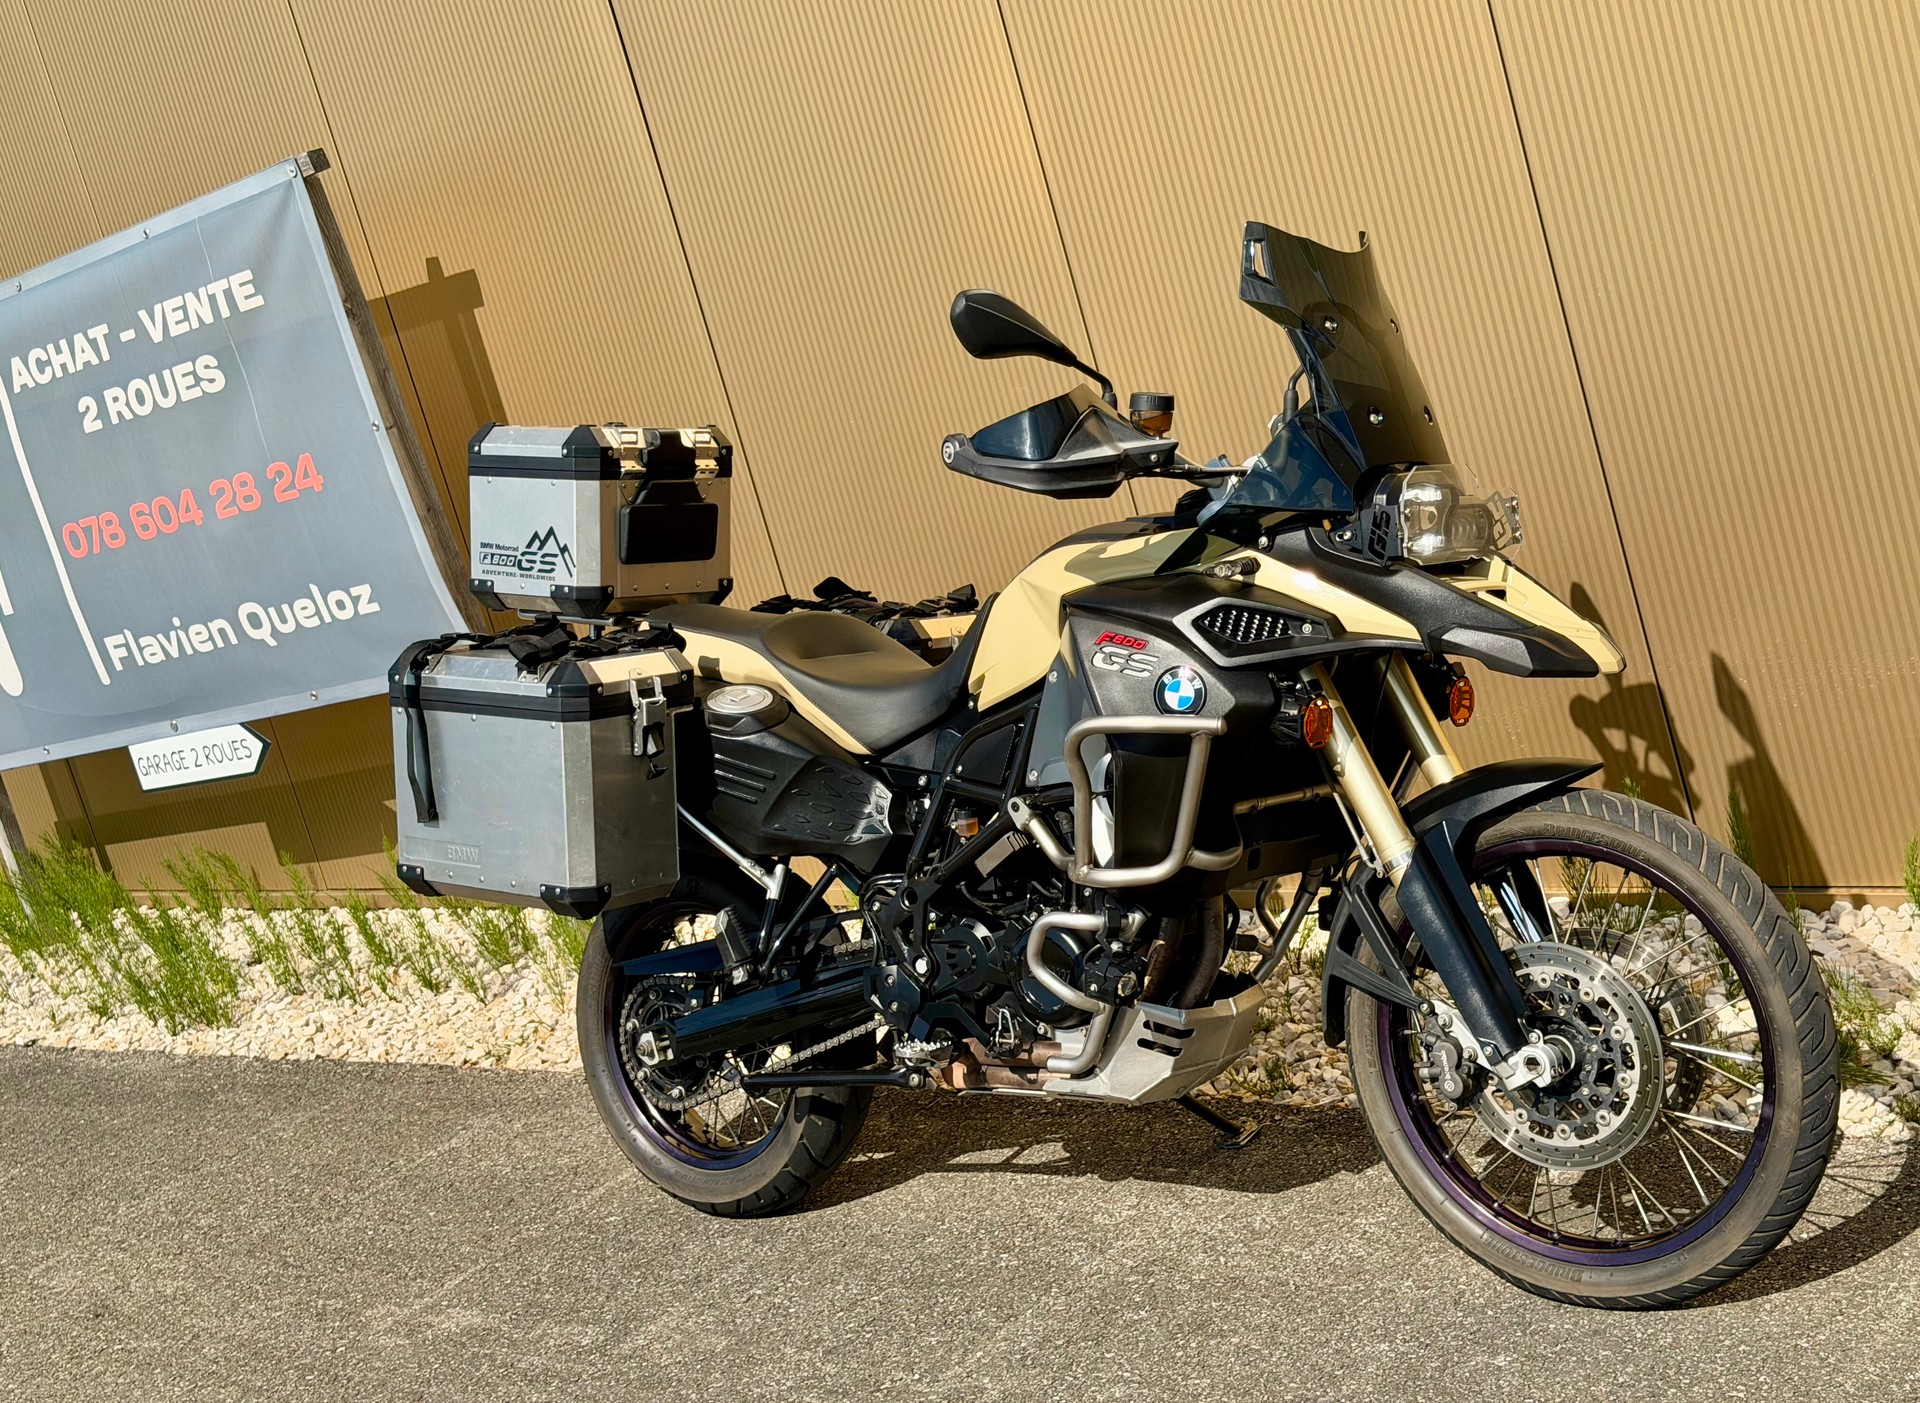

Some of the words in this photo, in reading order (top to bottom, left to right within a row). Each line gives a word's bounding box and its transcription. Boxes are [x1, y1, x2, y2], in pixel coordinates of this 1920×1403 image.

[10, 323, 111, 394] ACHAT
[137, 269, 265, 344] VENTE
[77, 396, 103, 434] 2
[103, 354, 226, 425] ROUES
[62, 511, 126, 559] 078
[129, 488, 204, 541] 604
[209, 471, 262, 520] 28
[266, 452, 324, 503] 24
[480, 541, 494, 550] BMW
[495, 543, 519, 552] Motorrad
[491, 554, 515, 566] 800
[517, 550, 559, 574] GS
[103, 616, 239, 672] Flavien
[238, 583, 381, 647] Queloz
[1094, 631, 1149, 650] F800
[1091, 646, 1160, 678] GS
[1162, 666, 1202, 690] BMW
[137, 750, 190, 777] GARAGE
[190, 748, 203, 768] 2
[202, 739, 252, 766] ROUES
[446, 845, 479, 863] BMW
[1542, 823, 1651, 862] BRIDGESTONE
